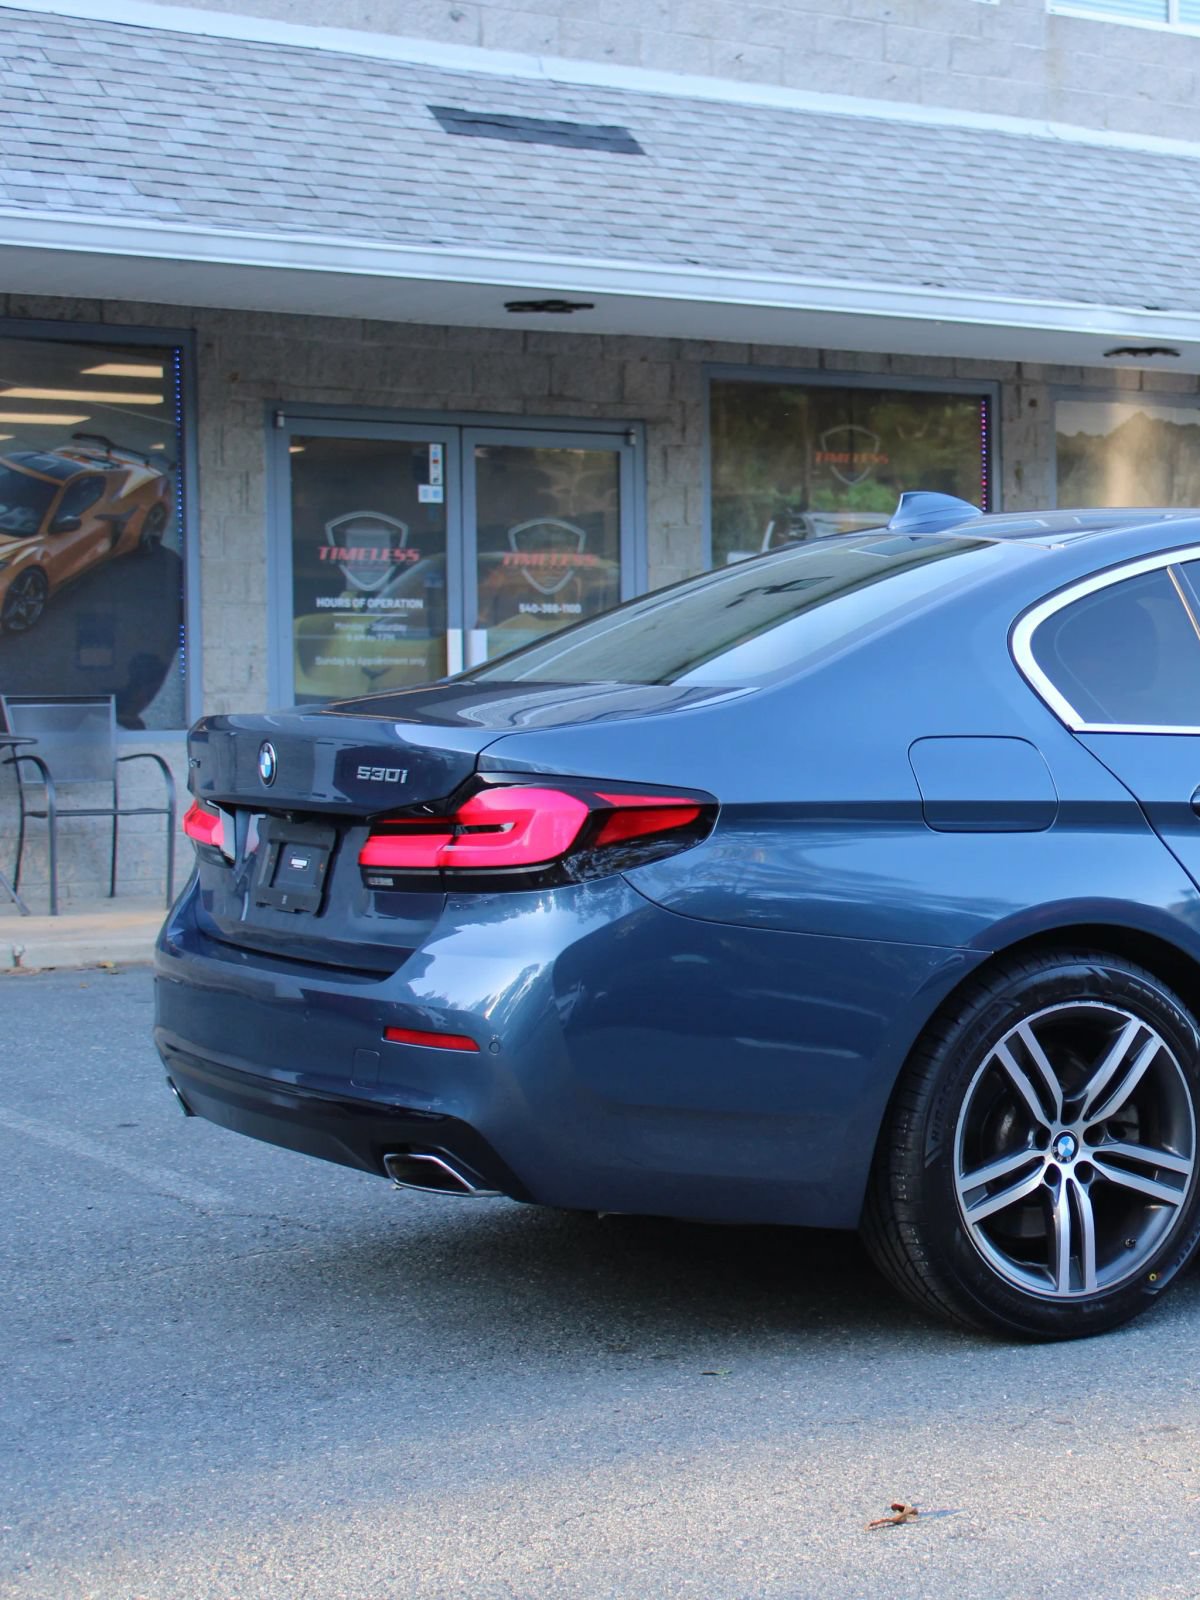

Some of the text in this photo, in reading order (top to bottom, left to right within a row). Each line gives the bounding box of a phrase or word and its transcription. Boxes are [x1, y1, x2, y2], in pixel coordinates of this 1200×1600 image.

[318, 546, 420, 562] TIMELESS
[502, 552, 599, 568] TIMELESS
[316, 597, 424, 610] HOURS OF OPERATION
[356, 765, 408, 785] 530i
